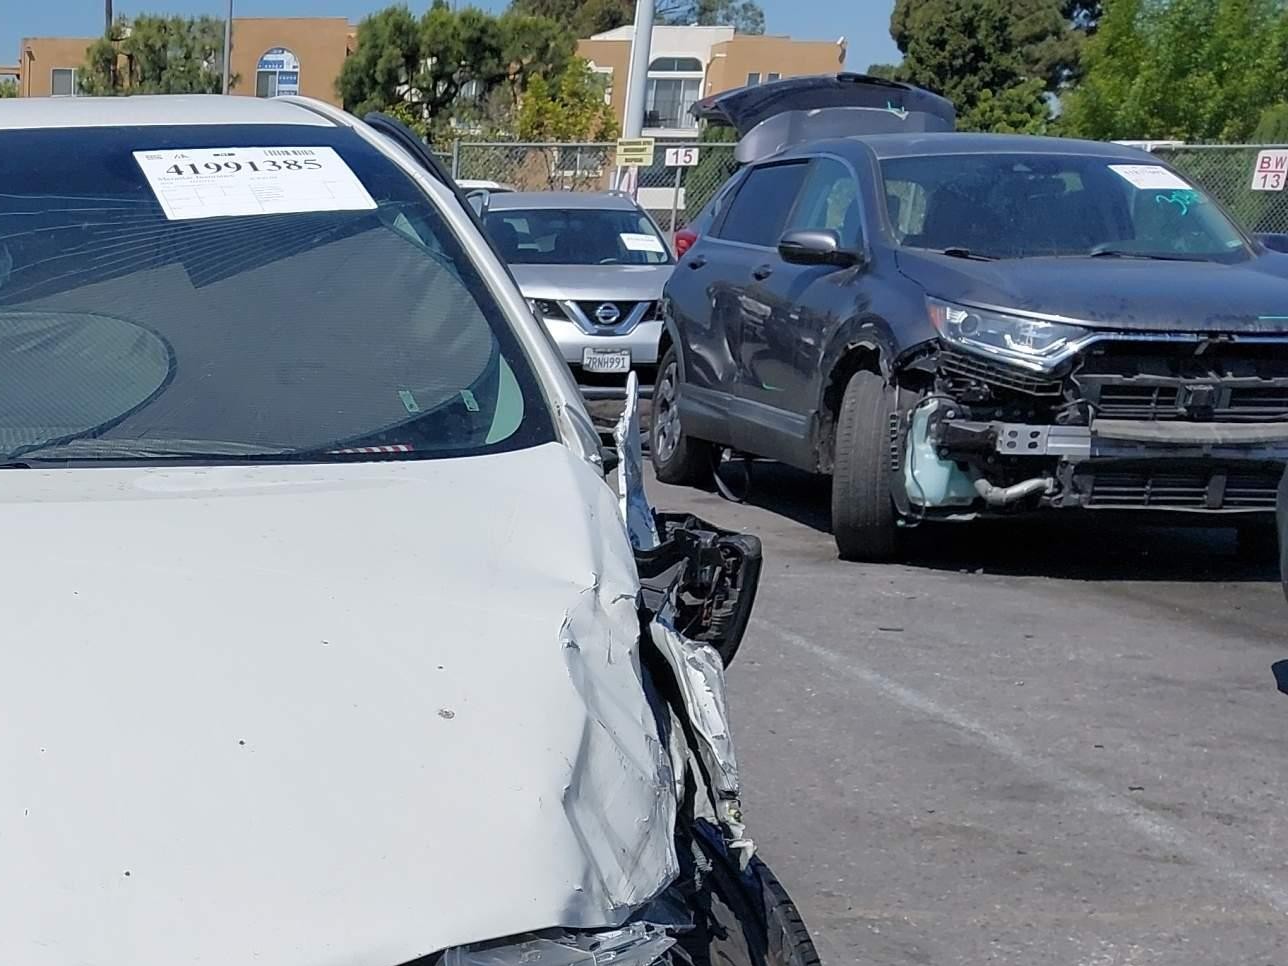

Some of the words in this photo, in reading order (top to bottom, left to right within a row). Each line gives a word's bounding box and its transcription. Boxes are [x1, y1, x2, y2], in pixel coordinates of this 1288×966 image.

[672, 149, 692, 164] 15
[166, 158, 323, 176] 41991385
[1260, 173, 1281, 188] 13
[586, 357, 626, 369] 7RNH991
